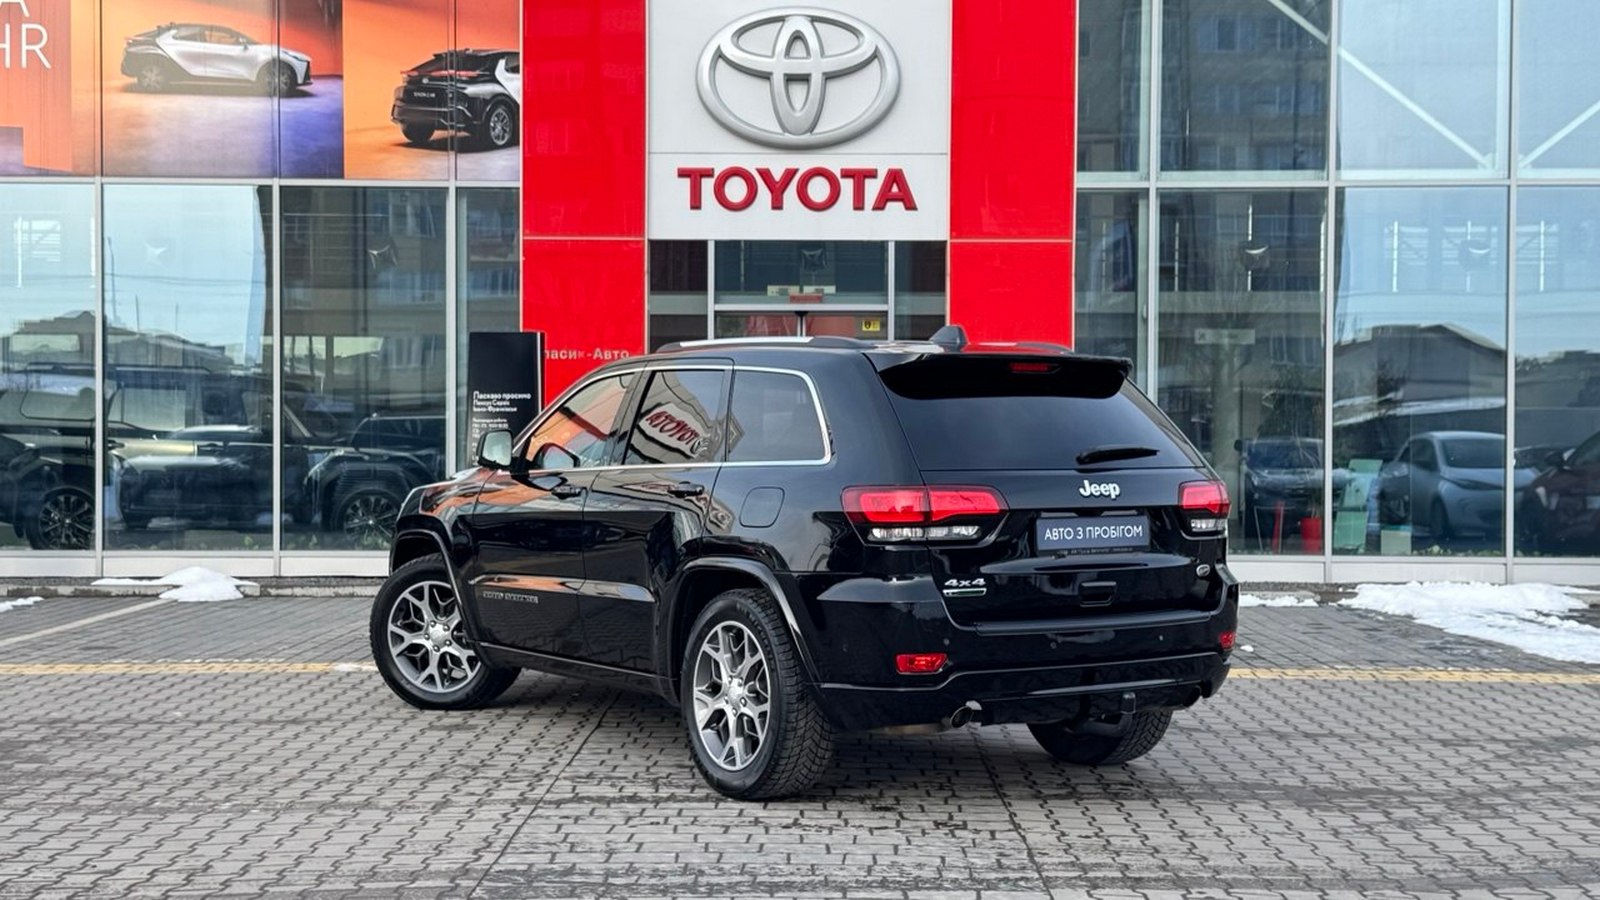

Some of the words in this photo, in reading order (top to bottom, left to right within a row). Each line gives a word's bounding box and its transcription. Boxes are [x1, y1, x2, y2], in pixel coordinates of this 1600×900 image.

[677, 166, 918, 212] TOYOTA
[1079, 480, 1121, 499] Jeep
[1044, 528, 1074, 540] АВТО
[1086, 525, 1143, 539] ПРОБІГОМ
[944, 578, 986, 587] 4x4
